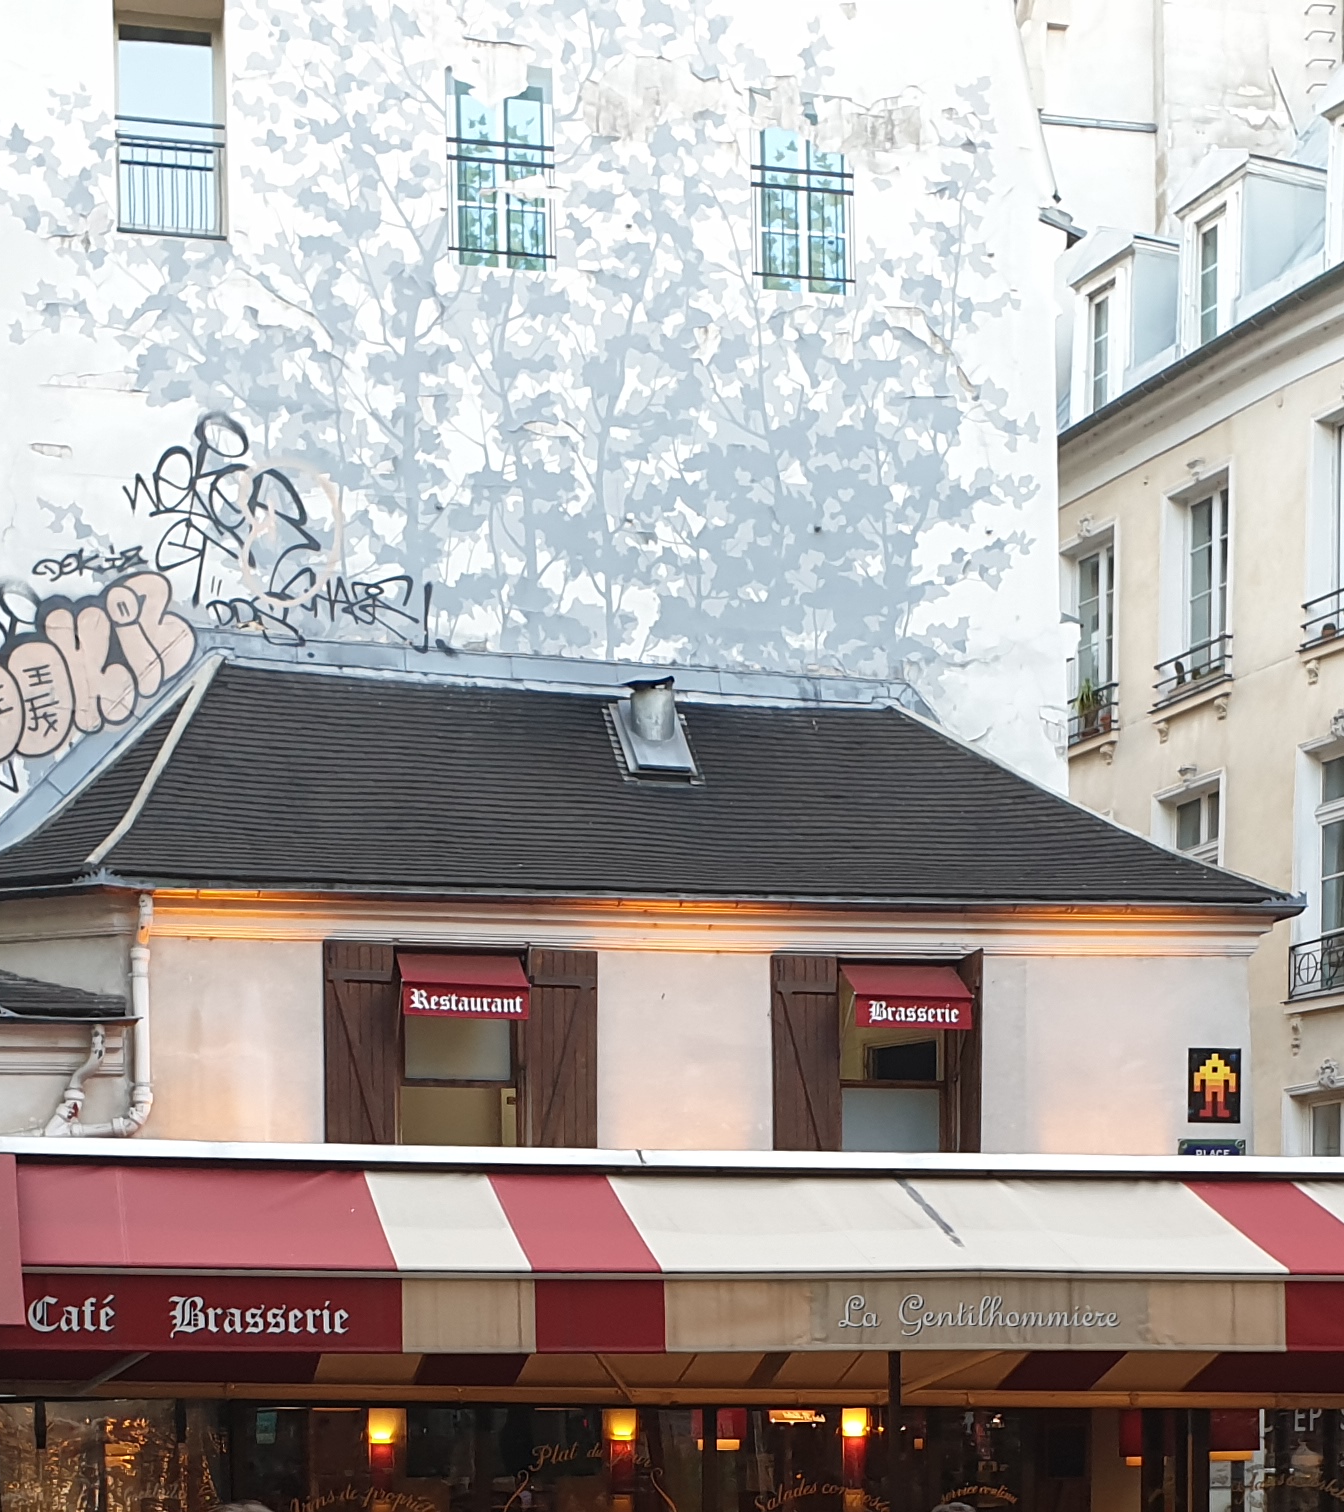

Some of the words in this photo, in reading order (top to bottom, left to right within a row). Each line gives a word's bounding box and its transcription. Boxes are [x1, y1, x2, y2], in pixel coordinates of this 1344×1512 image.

[409, 987, 524, 1014] Restaurant
[868, 1000, 961, 1025] Brasserie
[27, 1294, 116, 1332] Café
[168, 1295, 350, 1338] Brasserie
[838, 1294, 881, 1328] La
[898, 1294, 1121, 1337] Gentilhommière
